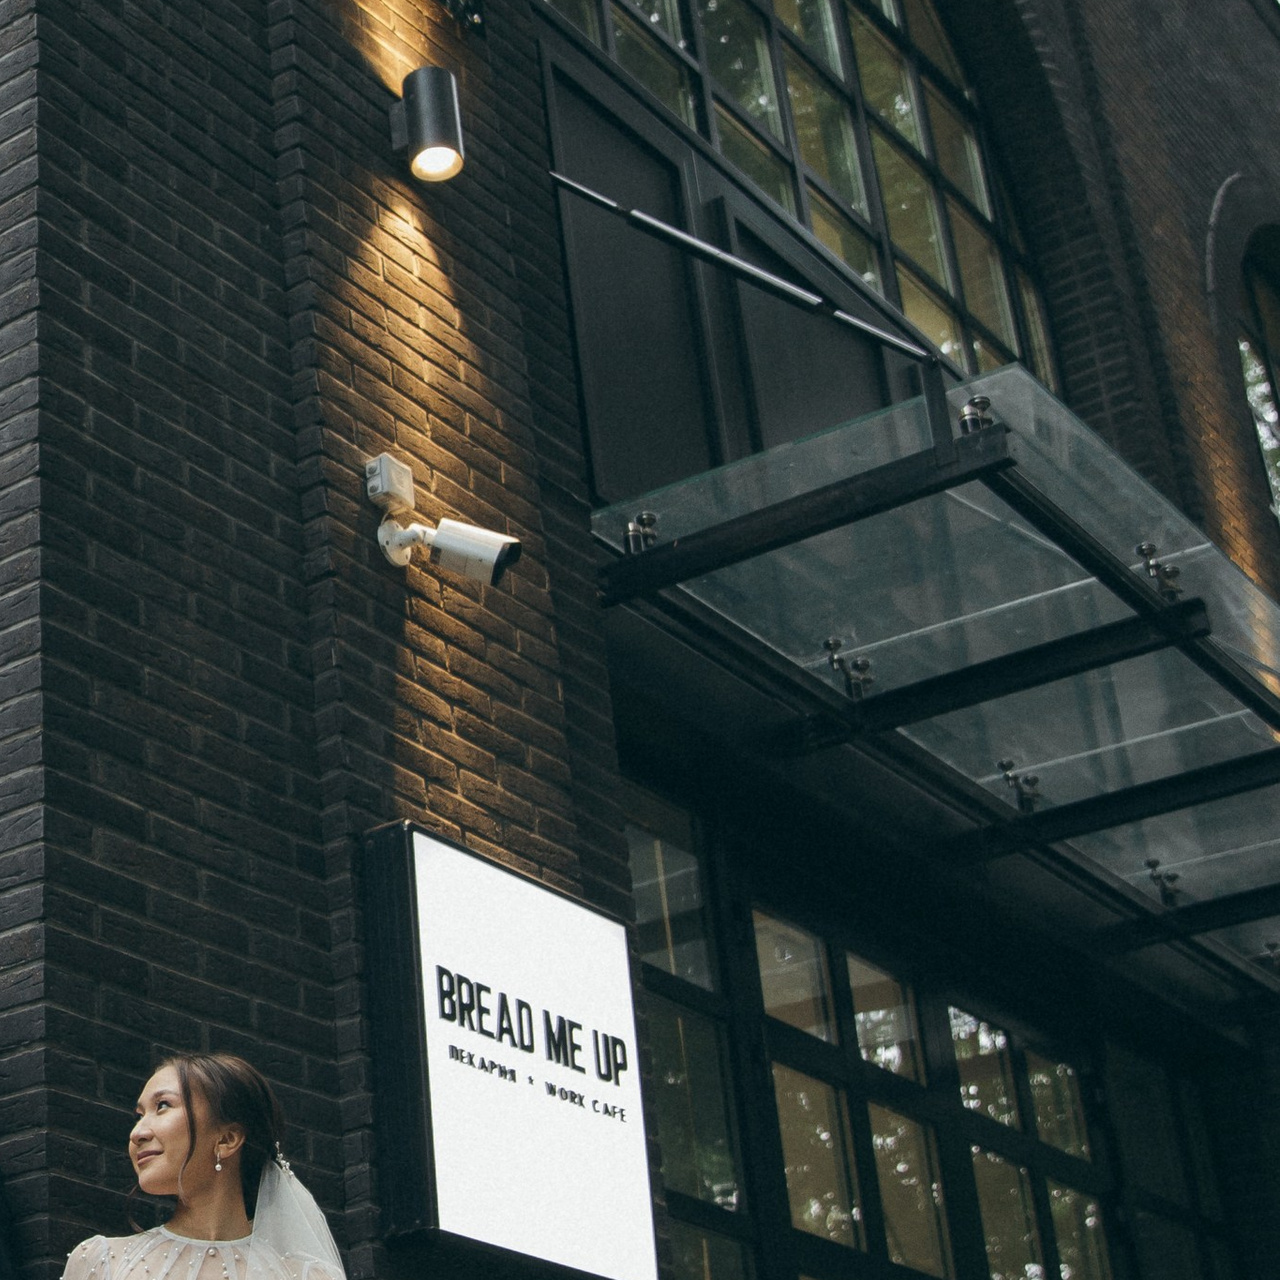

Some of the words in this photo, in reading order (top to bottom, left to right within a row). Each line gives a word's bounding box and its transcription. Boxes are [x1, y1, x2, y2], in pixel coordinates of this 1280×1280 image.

[435, 964, 535, 1054] BREAD
[542, 1009, 586, 1074] ME
[592, 1029, 628, 1087] UP
[448, 1044, 517, 1083] ПЕКАРНЯ
[544, 1081, 586, 1109] WORK
[591, 1099, 627, 1123] CAFE
